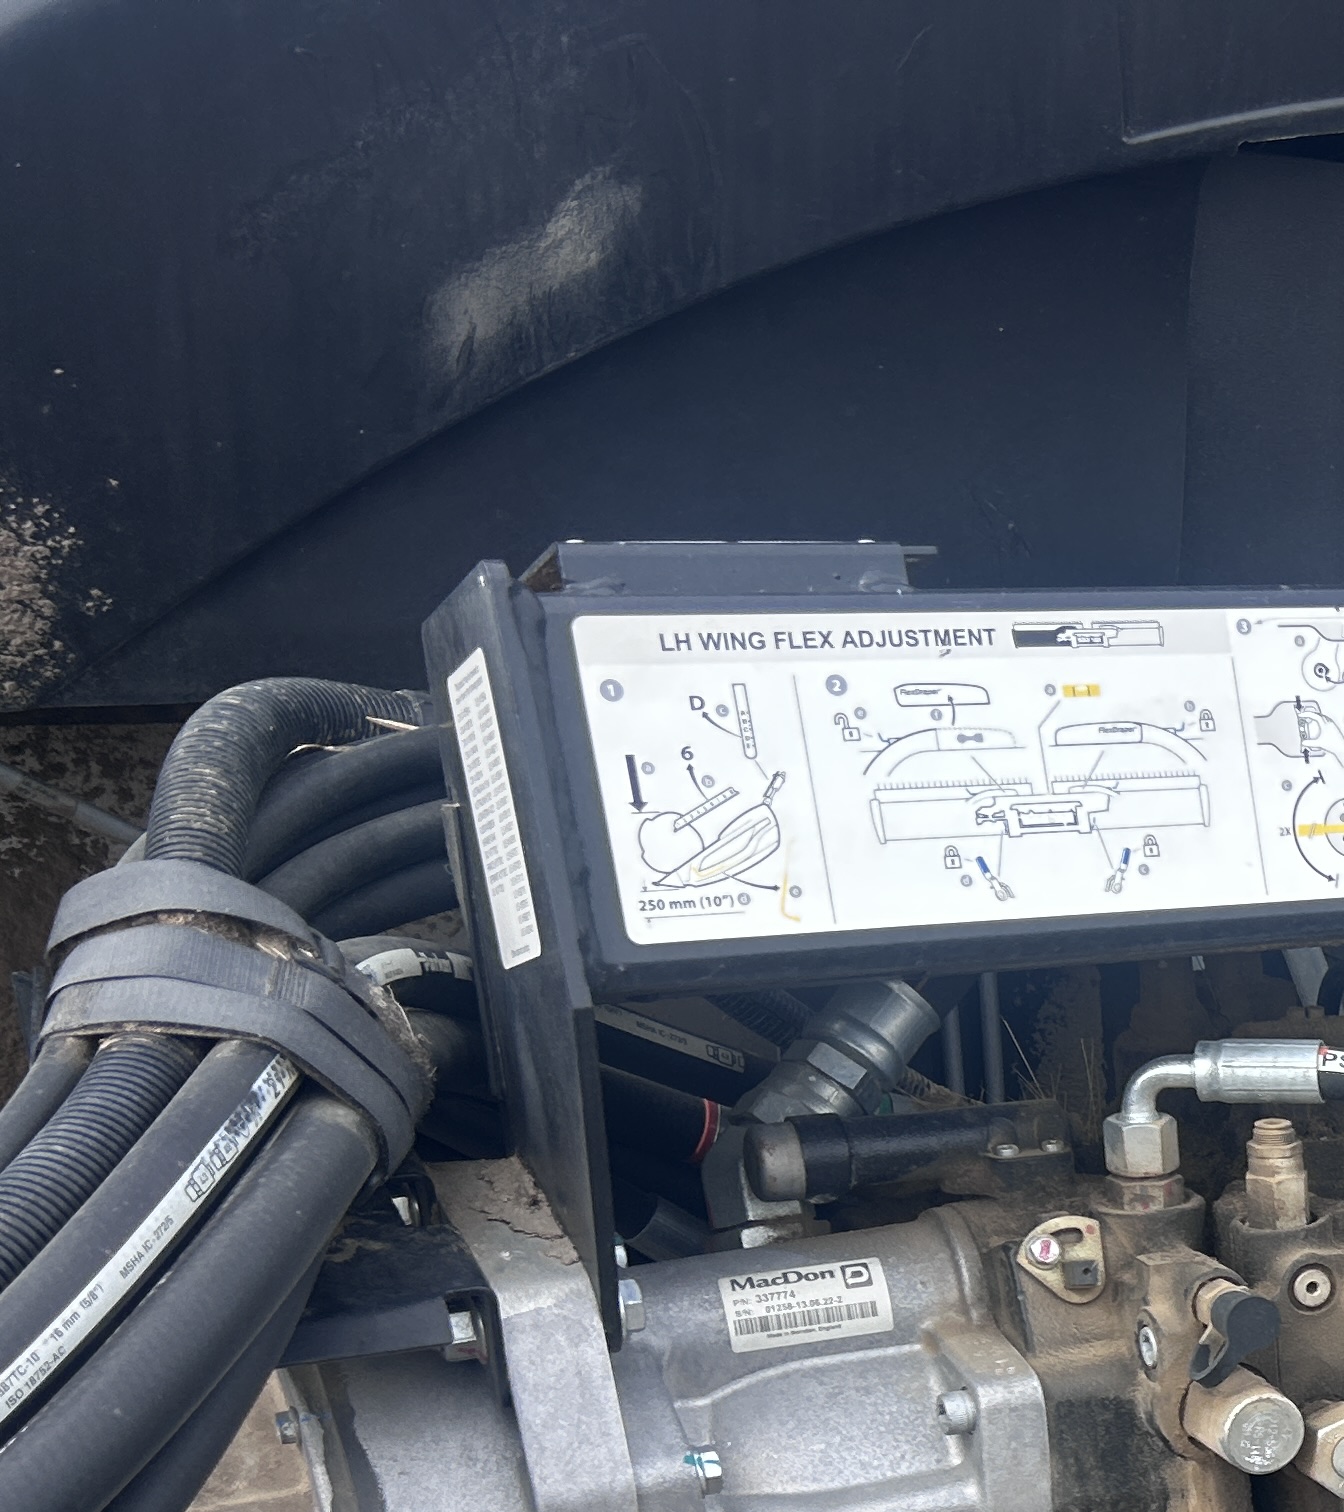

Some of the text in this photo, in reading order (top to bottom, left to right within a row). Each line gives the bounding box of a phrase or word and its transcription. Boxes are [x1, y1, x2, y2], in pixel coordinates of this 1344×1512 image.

[659, 629, 995, 651] LH WING FLEX ADJUSTMENT
[689, 696, 705, 710] D
[681, 746, 693, 760] 6
[639, 900, 665, 911] 250
[670, 900, 696, 910] mm
[119, 1252, 145, 1280] MSHA
[730, 1270, 835, 1292] MacDon
[755, 1290, 796, 1303] 337774
[62, 1311, 81, 1330] mm
[5, 1389, 25, 1409] ISO
